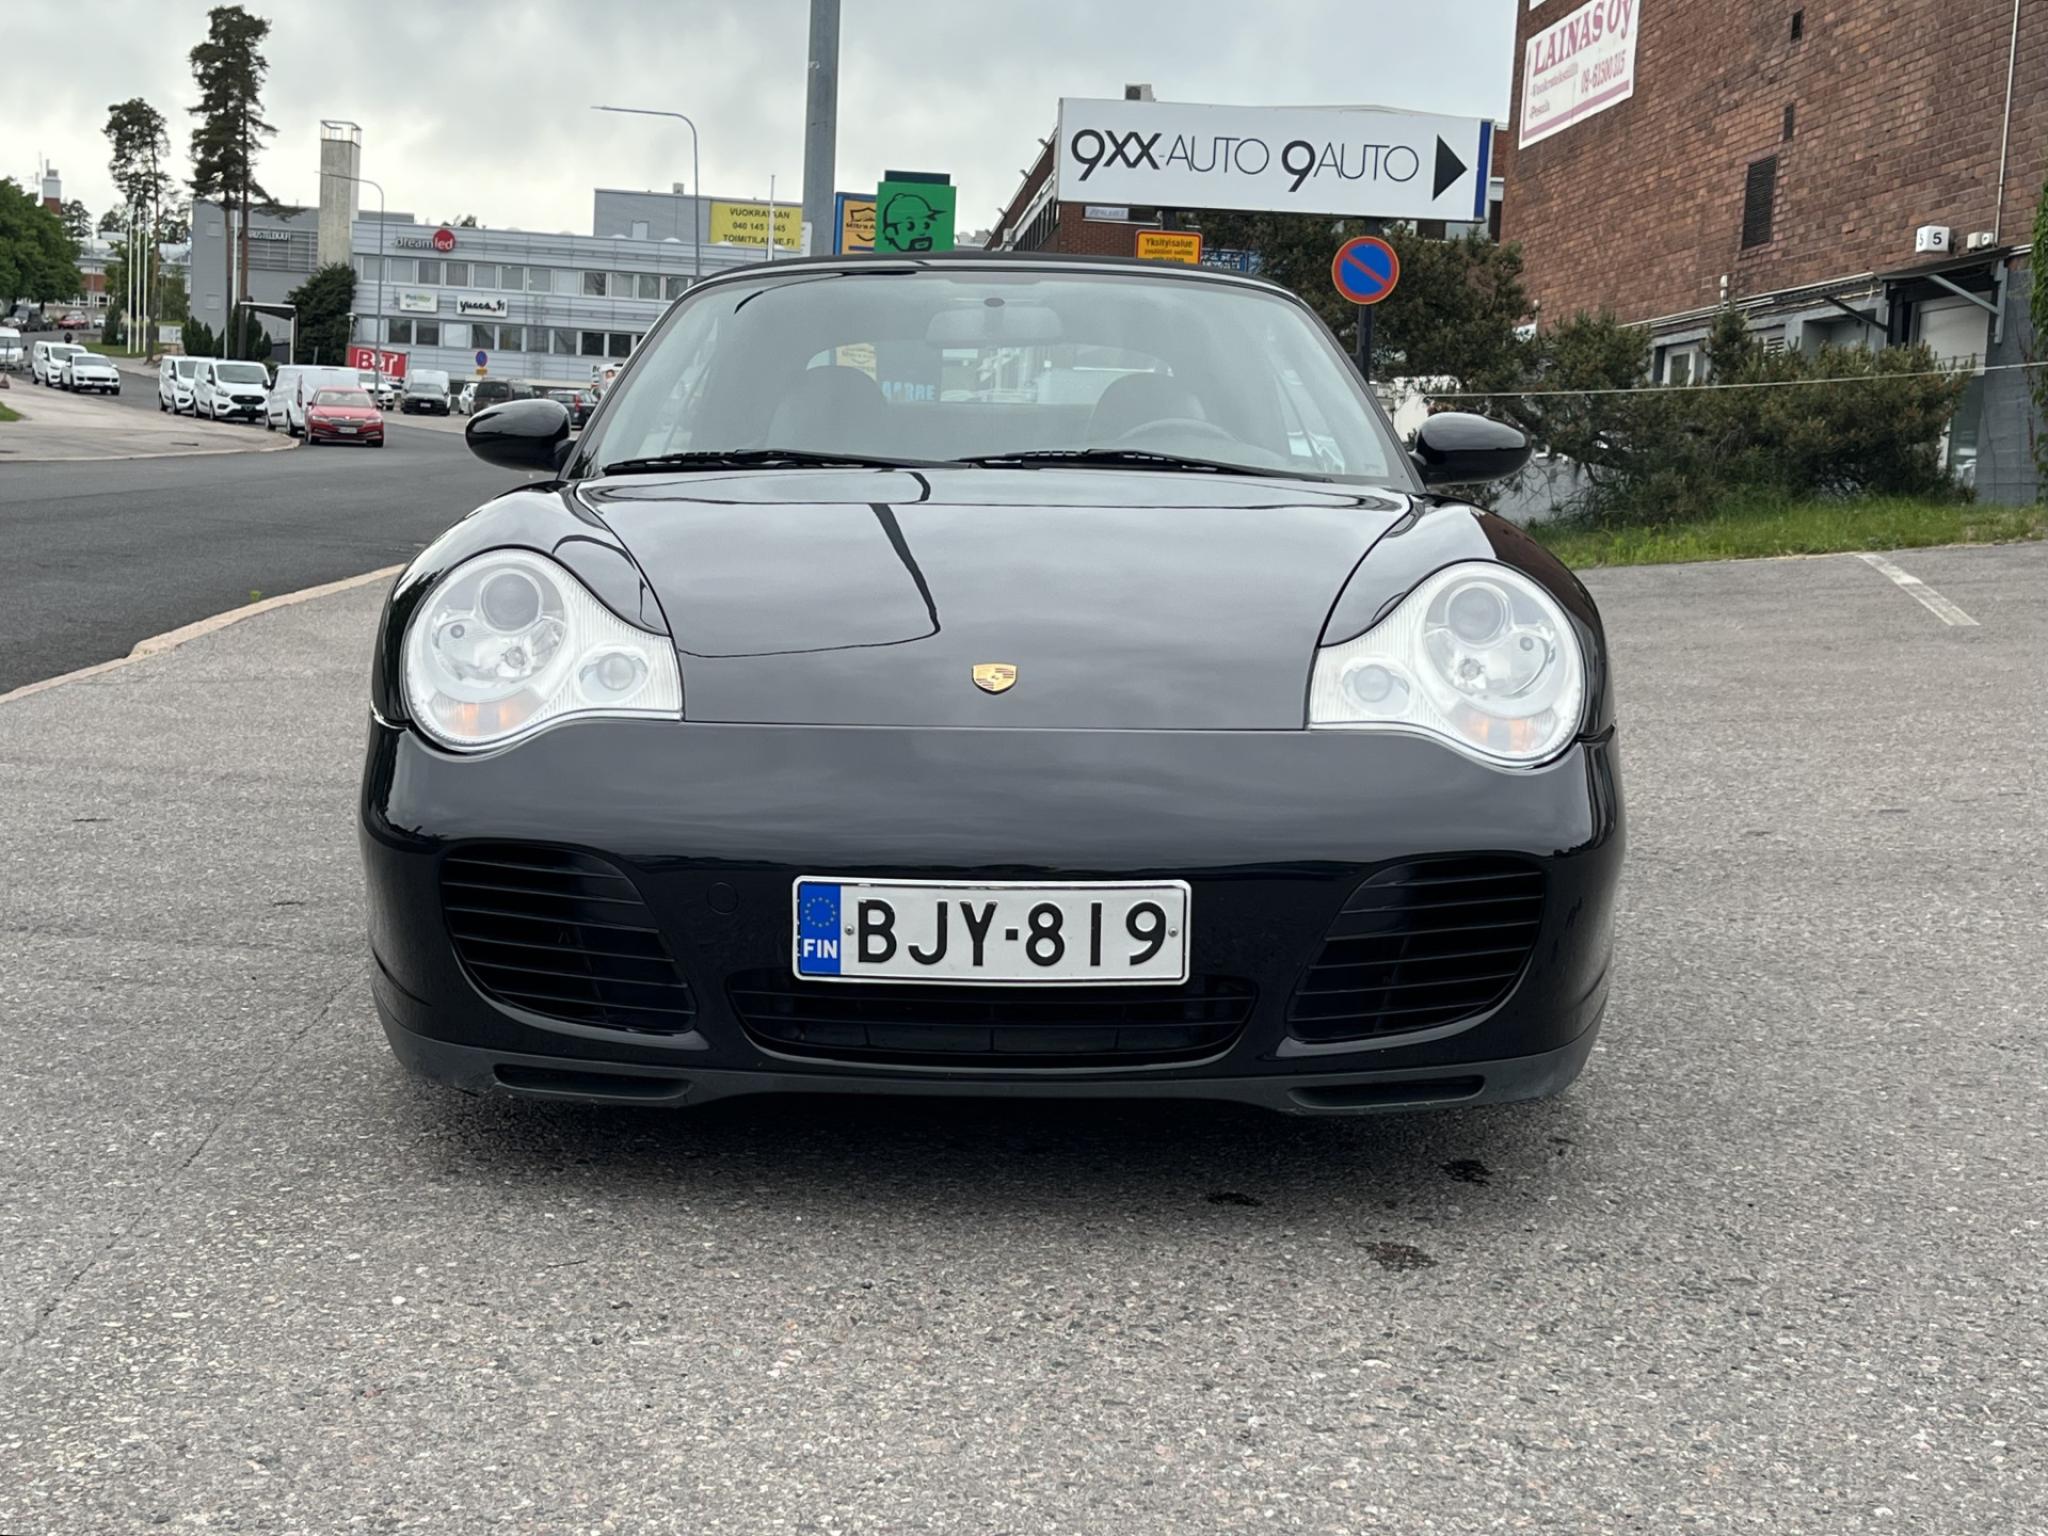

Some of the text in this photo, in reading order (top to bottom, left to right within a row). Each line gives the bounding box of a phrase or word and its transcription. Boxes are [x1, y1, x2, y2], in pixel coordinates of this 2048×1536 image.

[1534, 2, 1604, 76] LAINAS
[1071, 129, 1419, 192] 9XX-AUTO 9AUTO
[767, 224, 786, 232] 45
[1932, 232, 1942, 245] 5
[723, 234, 795, 246] TOIMITILANE.FI
[858, 898, 1167, 967] BJY-819
[803, 938, 838, 959] FIN
